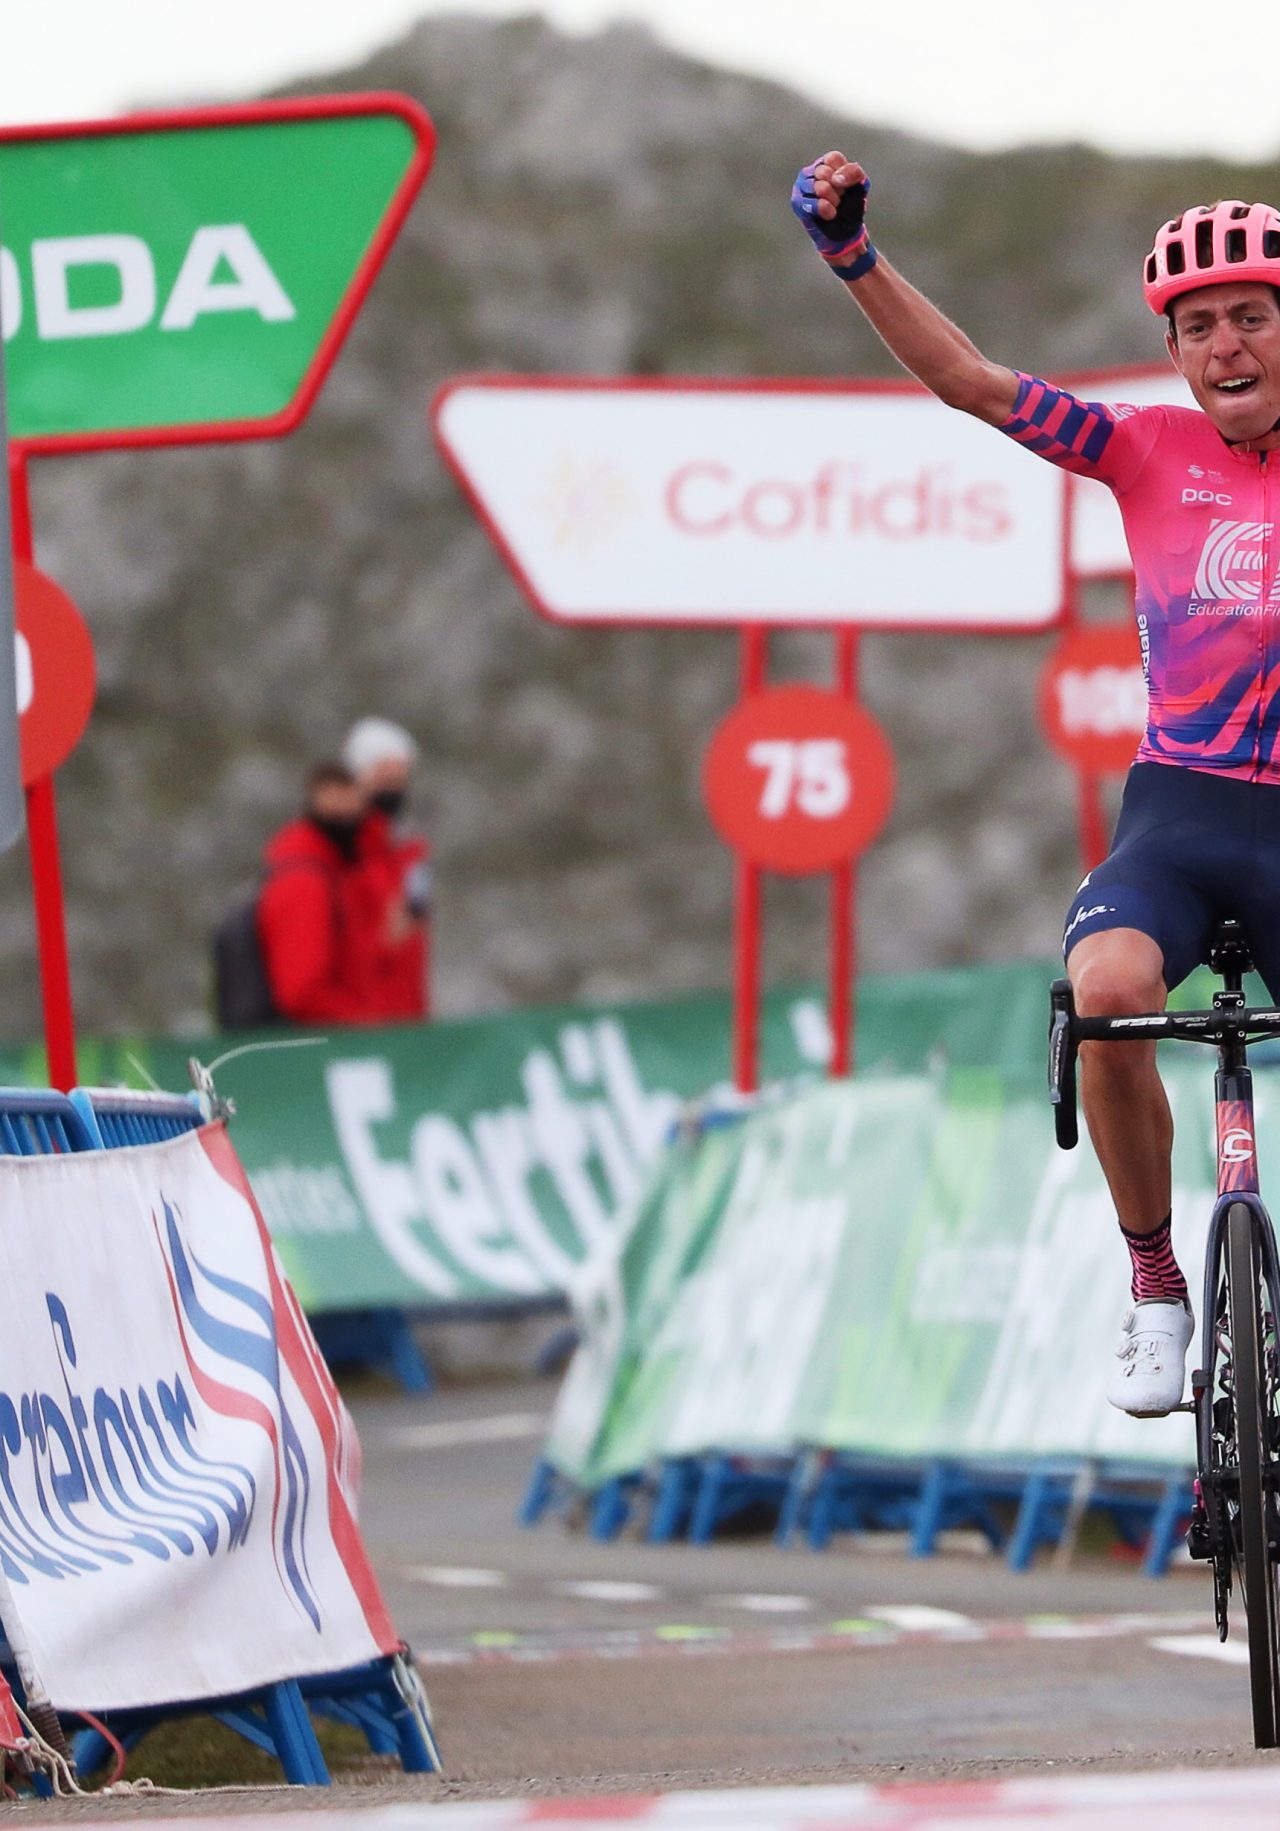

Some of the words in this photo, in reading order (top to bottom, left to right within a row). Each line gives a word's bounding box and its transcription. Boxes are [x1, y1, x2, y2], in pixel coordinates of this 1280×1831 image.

[1, 222, 297, 343] DA
[663, 458, 1016, 542] Cofidis
[1181, 488, 1233, 506] poc
[745, 737, 853, 820] 75
